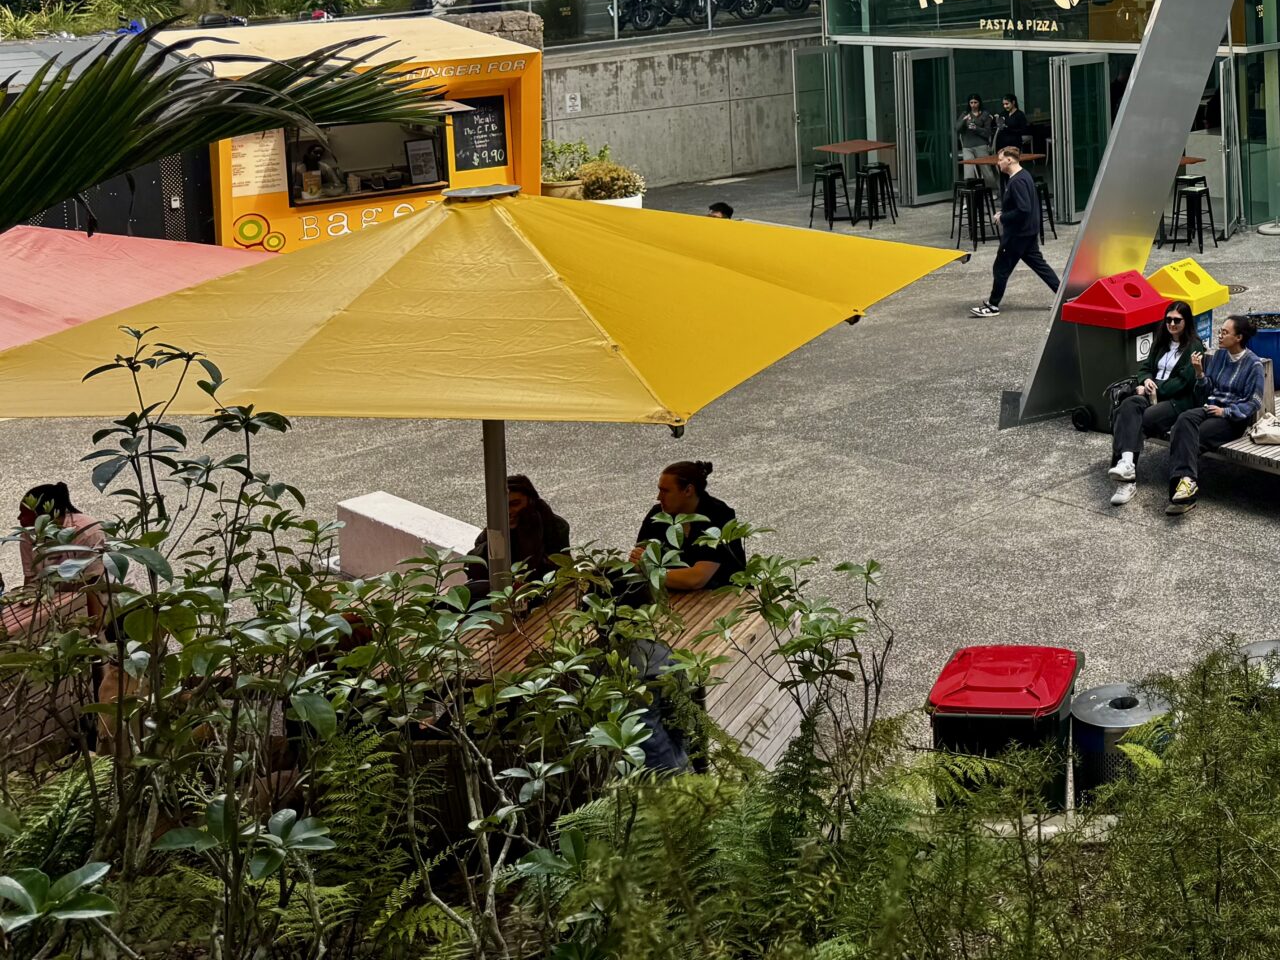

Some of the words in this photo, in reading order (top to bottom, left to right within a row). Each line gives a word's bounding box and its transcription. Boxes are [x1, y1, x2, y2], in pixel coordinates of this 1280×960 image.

[979, 18, 1014, 31] PASTA
[1016, 20, 1024, 31] &
[1026, 19, 1058, 32] PIZZA
[487, 59, 526, 73] FOR
[473, 114, 495, 125] Meal:
[472, 149, 505, 166] $9.90
[299, 200, 436, 241] Bage
